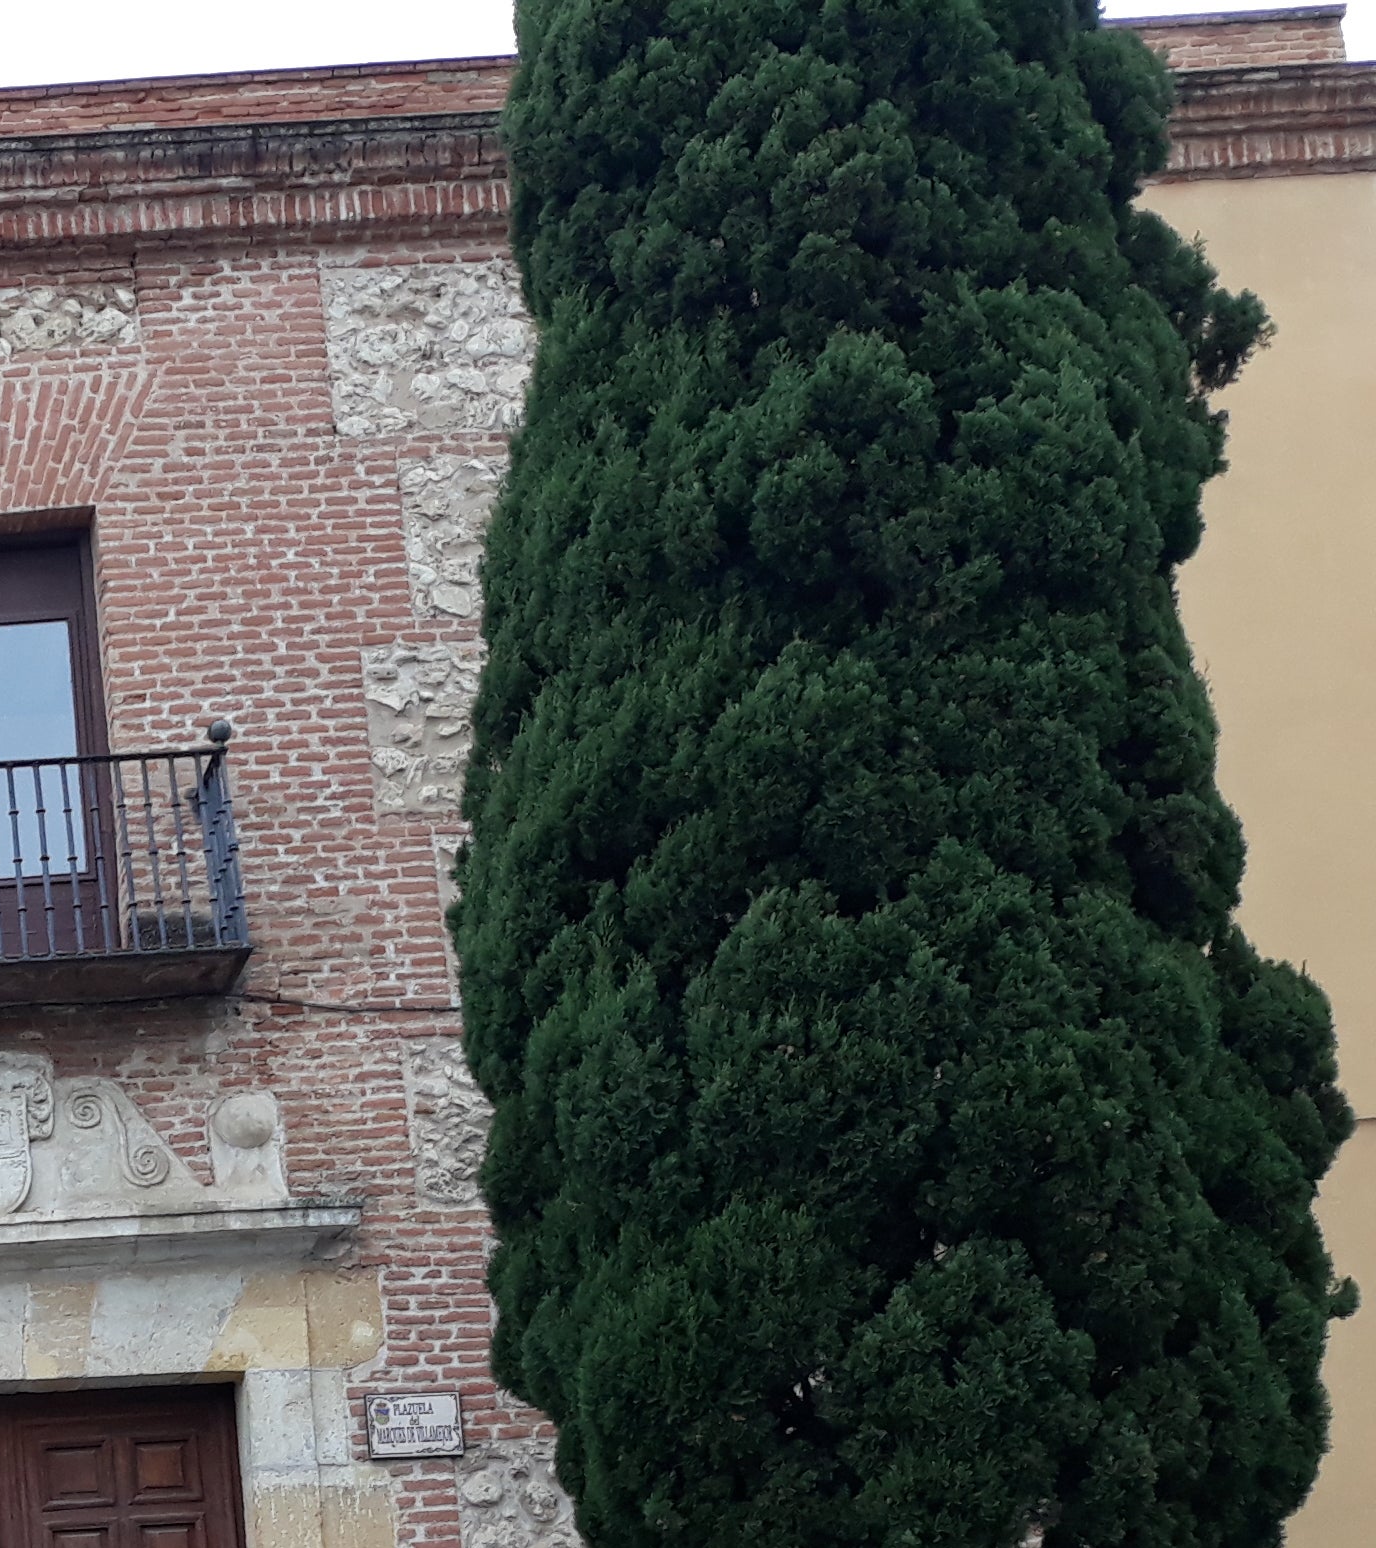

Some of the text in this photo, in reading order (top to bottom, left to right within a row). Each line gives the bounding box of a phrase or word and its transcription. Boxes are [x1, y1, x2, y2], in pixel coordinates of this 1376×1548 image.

[393, 1402, 434, 1416] PLAZUELA
[409, 1415, 420, 1425] del
[407, 1426, 416, 1443] DE
